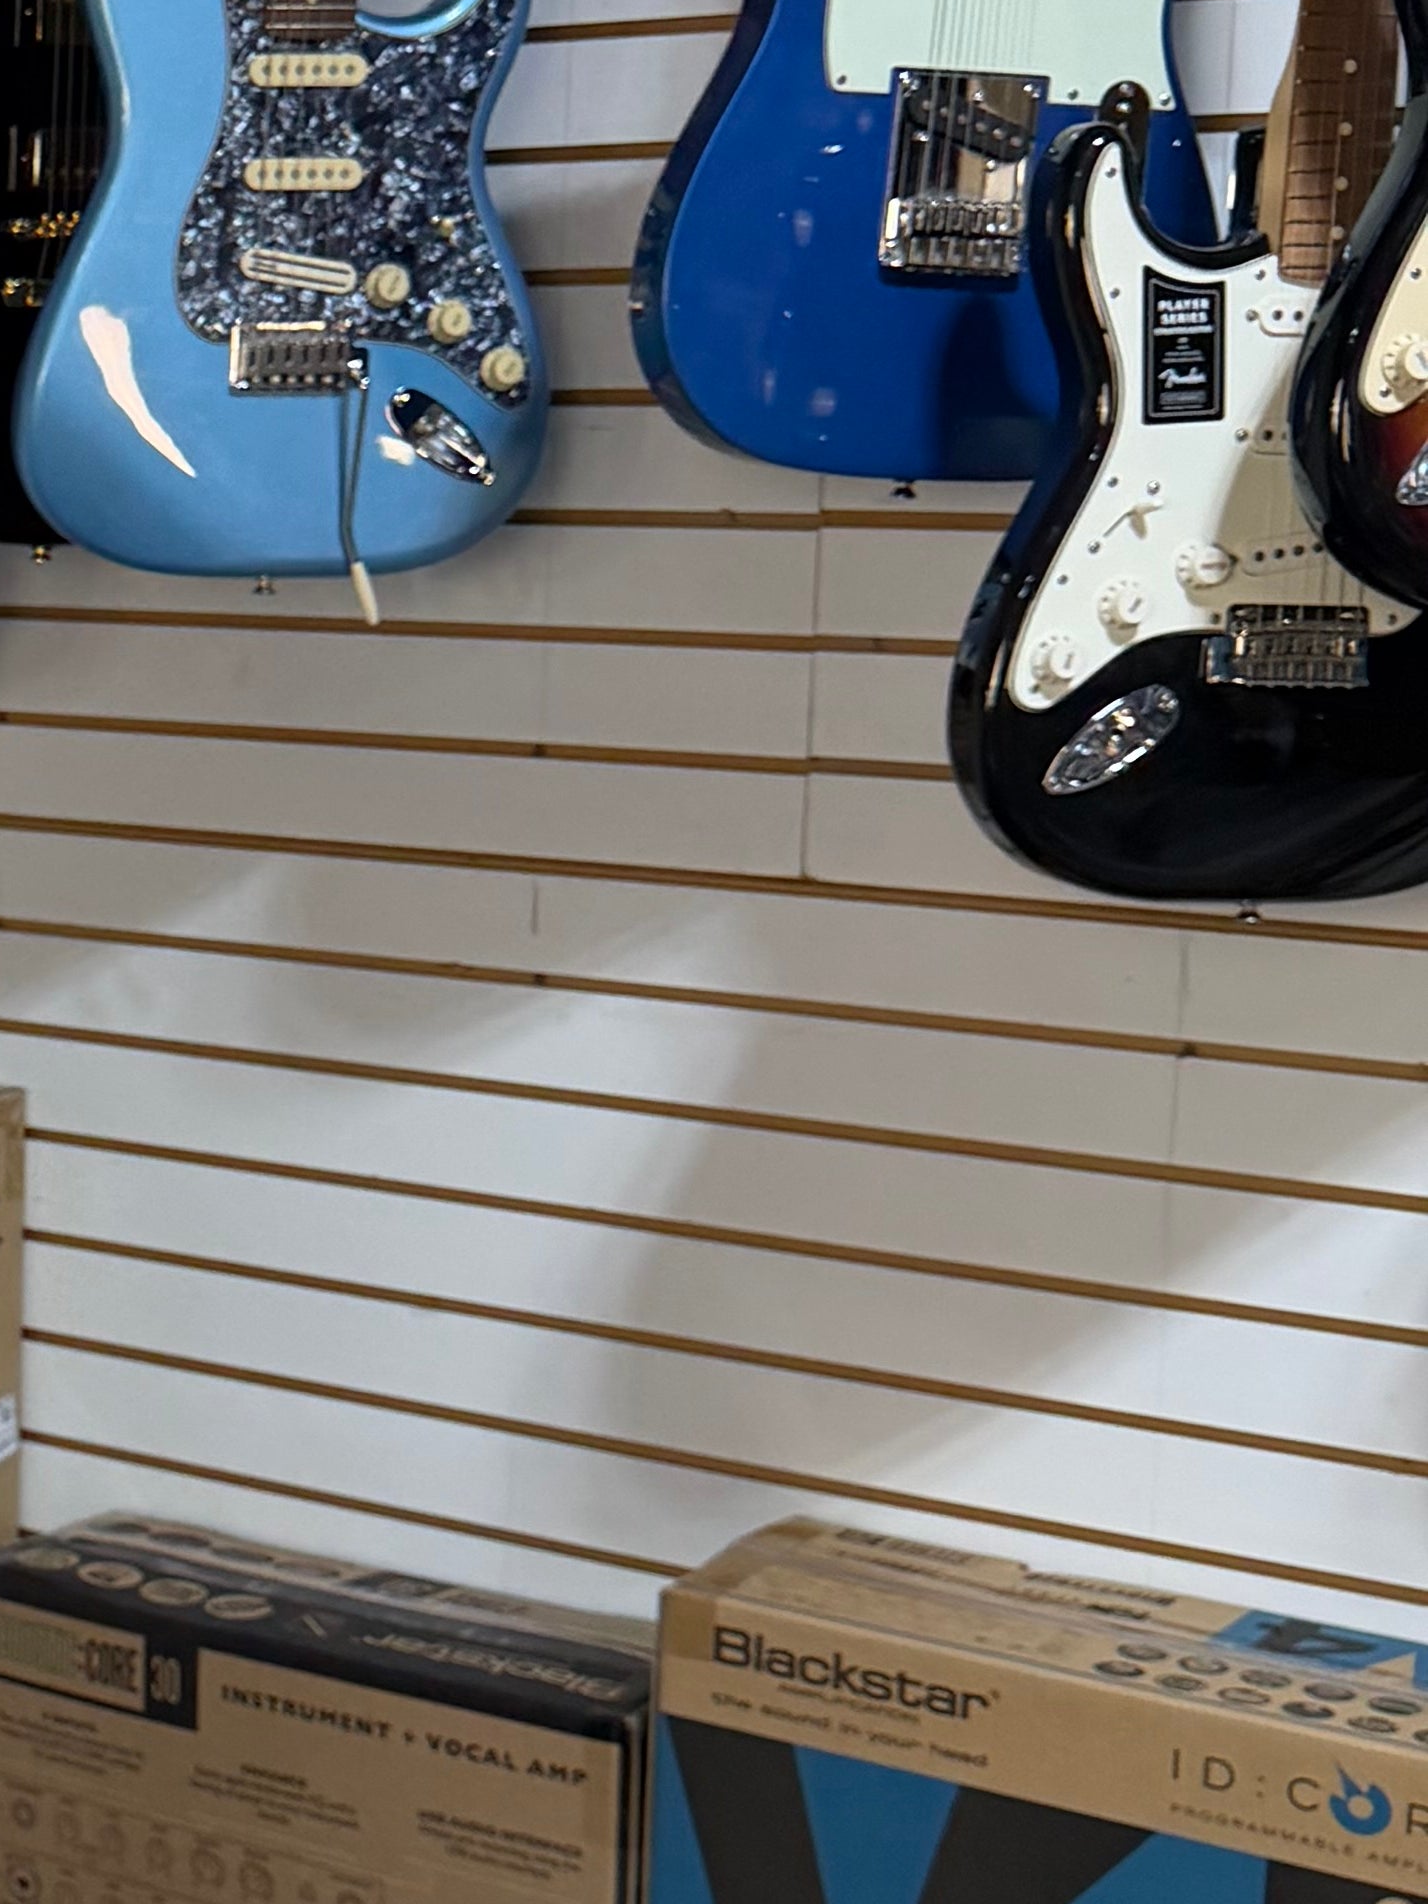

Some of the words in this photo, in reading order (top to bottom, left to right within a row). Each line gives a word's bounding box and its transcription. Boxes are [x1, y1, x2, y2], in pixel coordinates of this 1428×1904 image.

[1157, 298, 1211, 313] PLAYER
[1160, 311, 1209, 326] SERIES
[712, 1625, 991, 1720] Blackstar
[221, 1685, 393, 1740] INSTRUMENT
[425, 1731, 519, 1773] VOCAL
[525, 1757, 590, 1786] AMP
[1169, 1801, 1355, 1856] PROGRAMMABLE
[1367, 1850, 1428, 1873] AMPL
